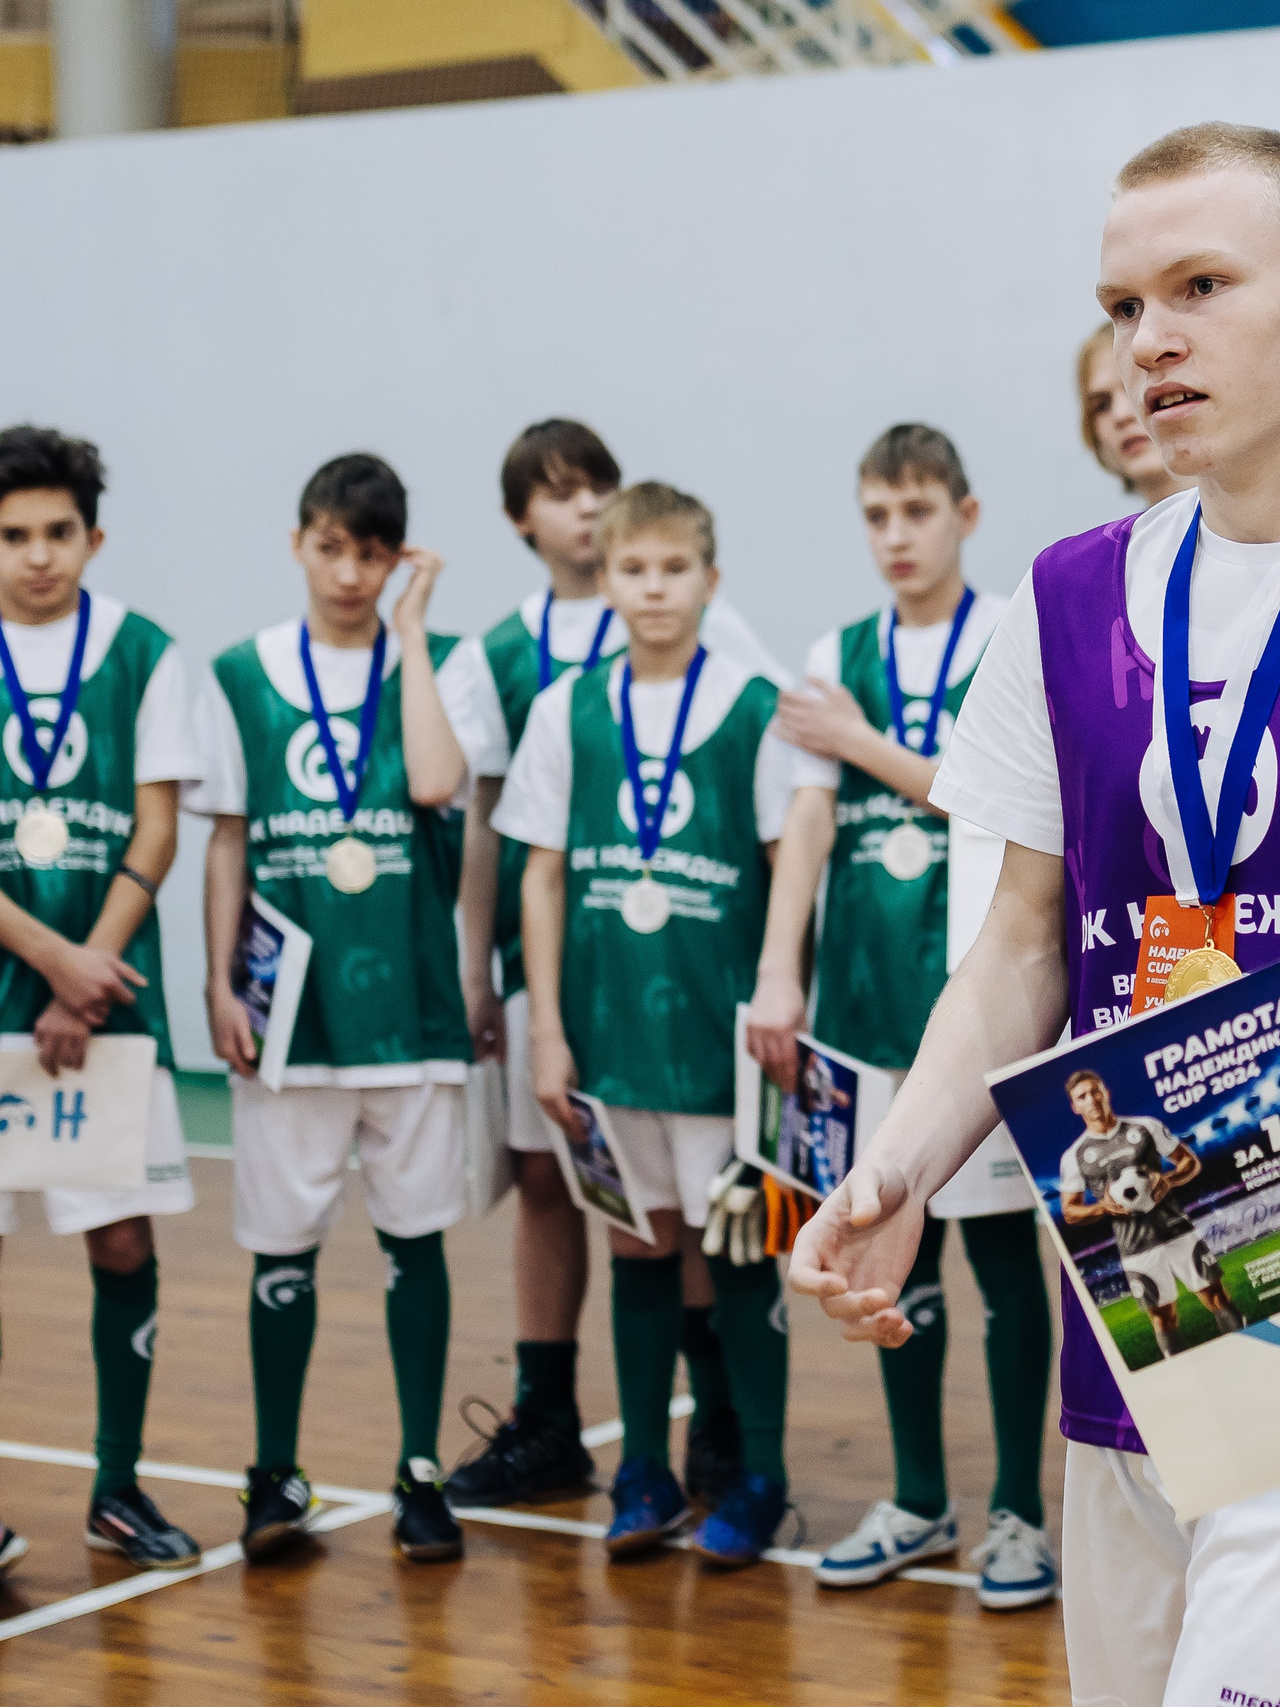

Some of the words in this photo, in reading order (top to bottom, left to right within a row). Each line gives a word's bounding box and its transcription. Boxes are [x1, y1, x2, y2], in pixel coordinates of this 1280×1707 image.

[1147, 961, 1174, 974] CUP
[1163, 1083, 1207, 1114] CUP
[1209, 1061, 1262, 1096] 2024
[1233, 1143, 1264, 1169] ЗА
